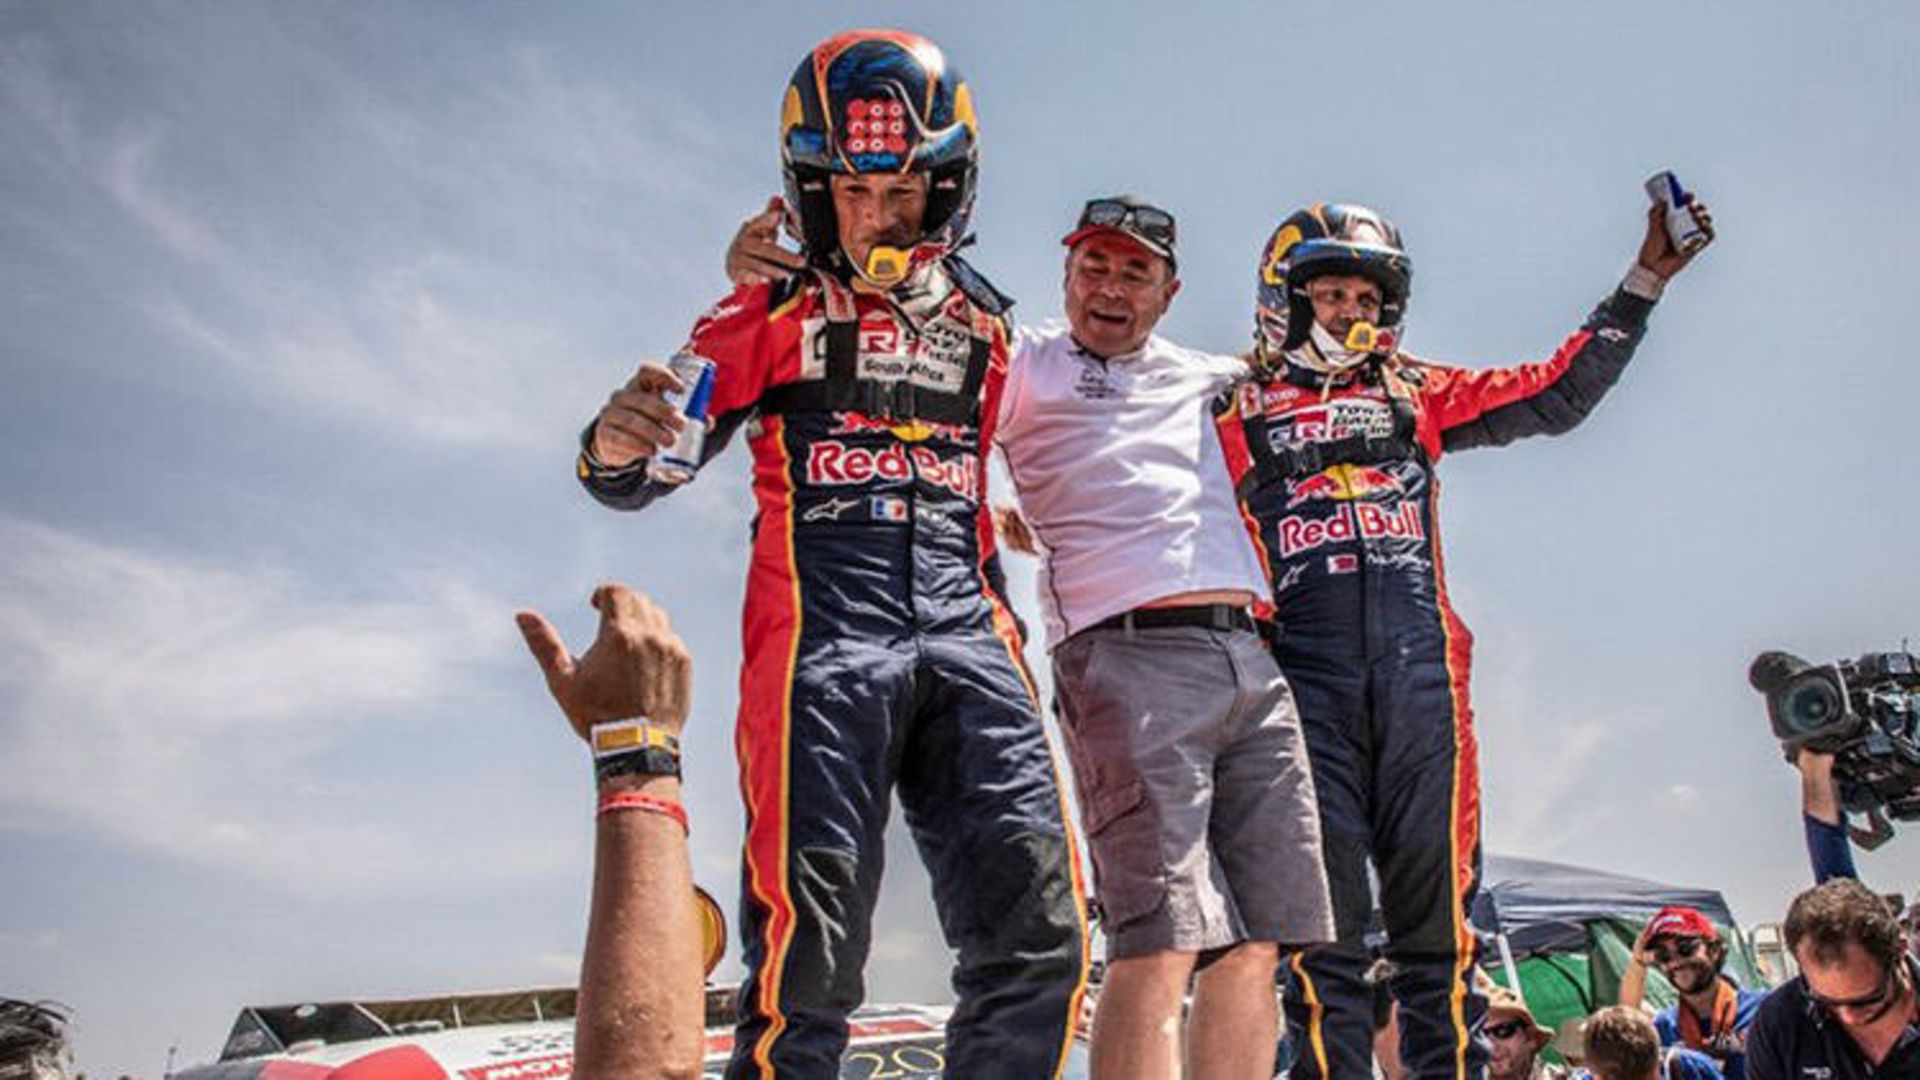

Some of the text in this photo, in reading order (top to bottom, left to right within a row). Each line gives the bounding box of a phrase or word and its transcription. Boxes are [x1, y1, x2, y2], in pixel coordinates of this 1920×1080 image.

[807, 440, 914, 485] Red
[1279, 500, 1426, 560] Red Bull
